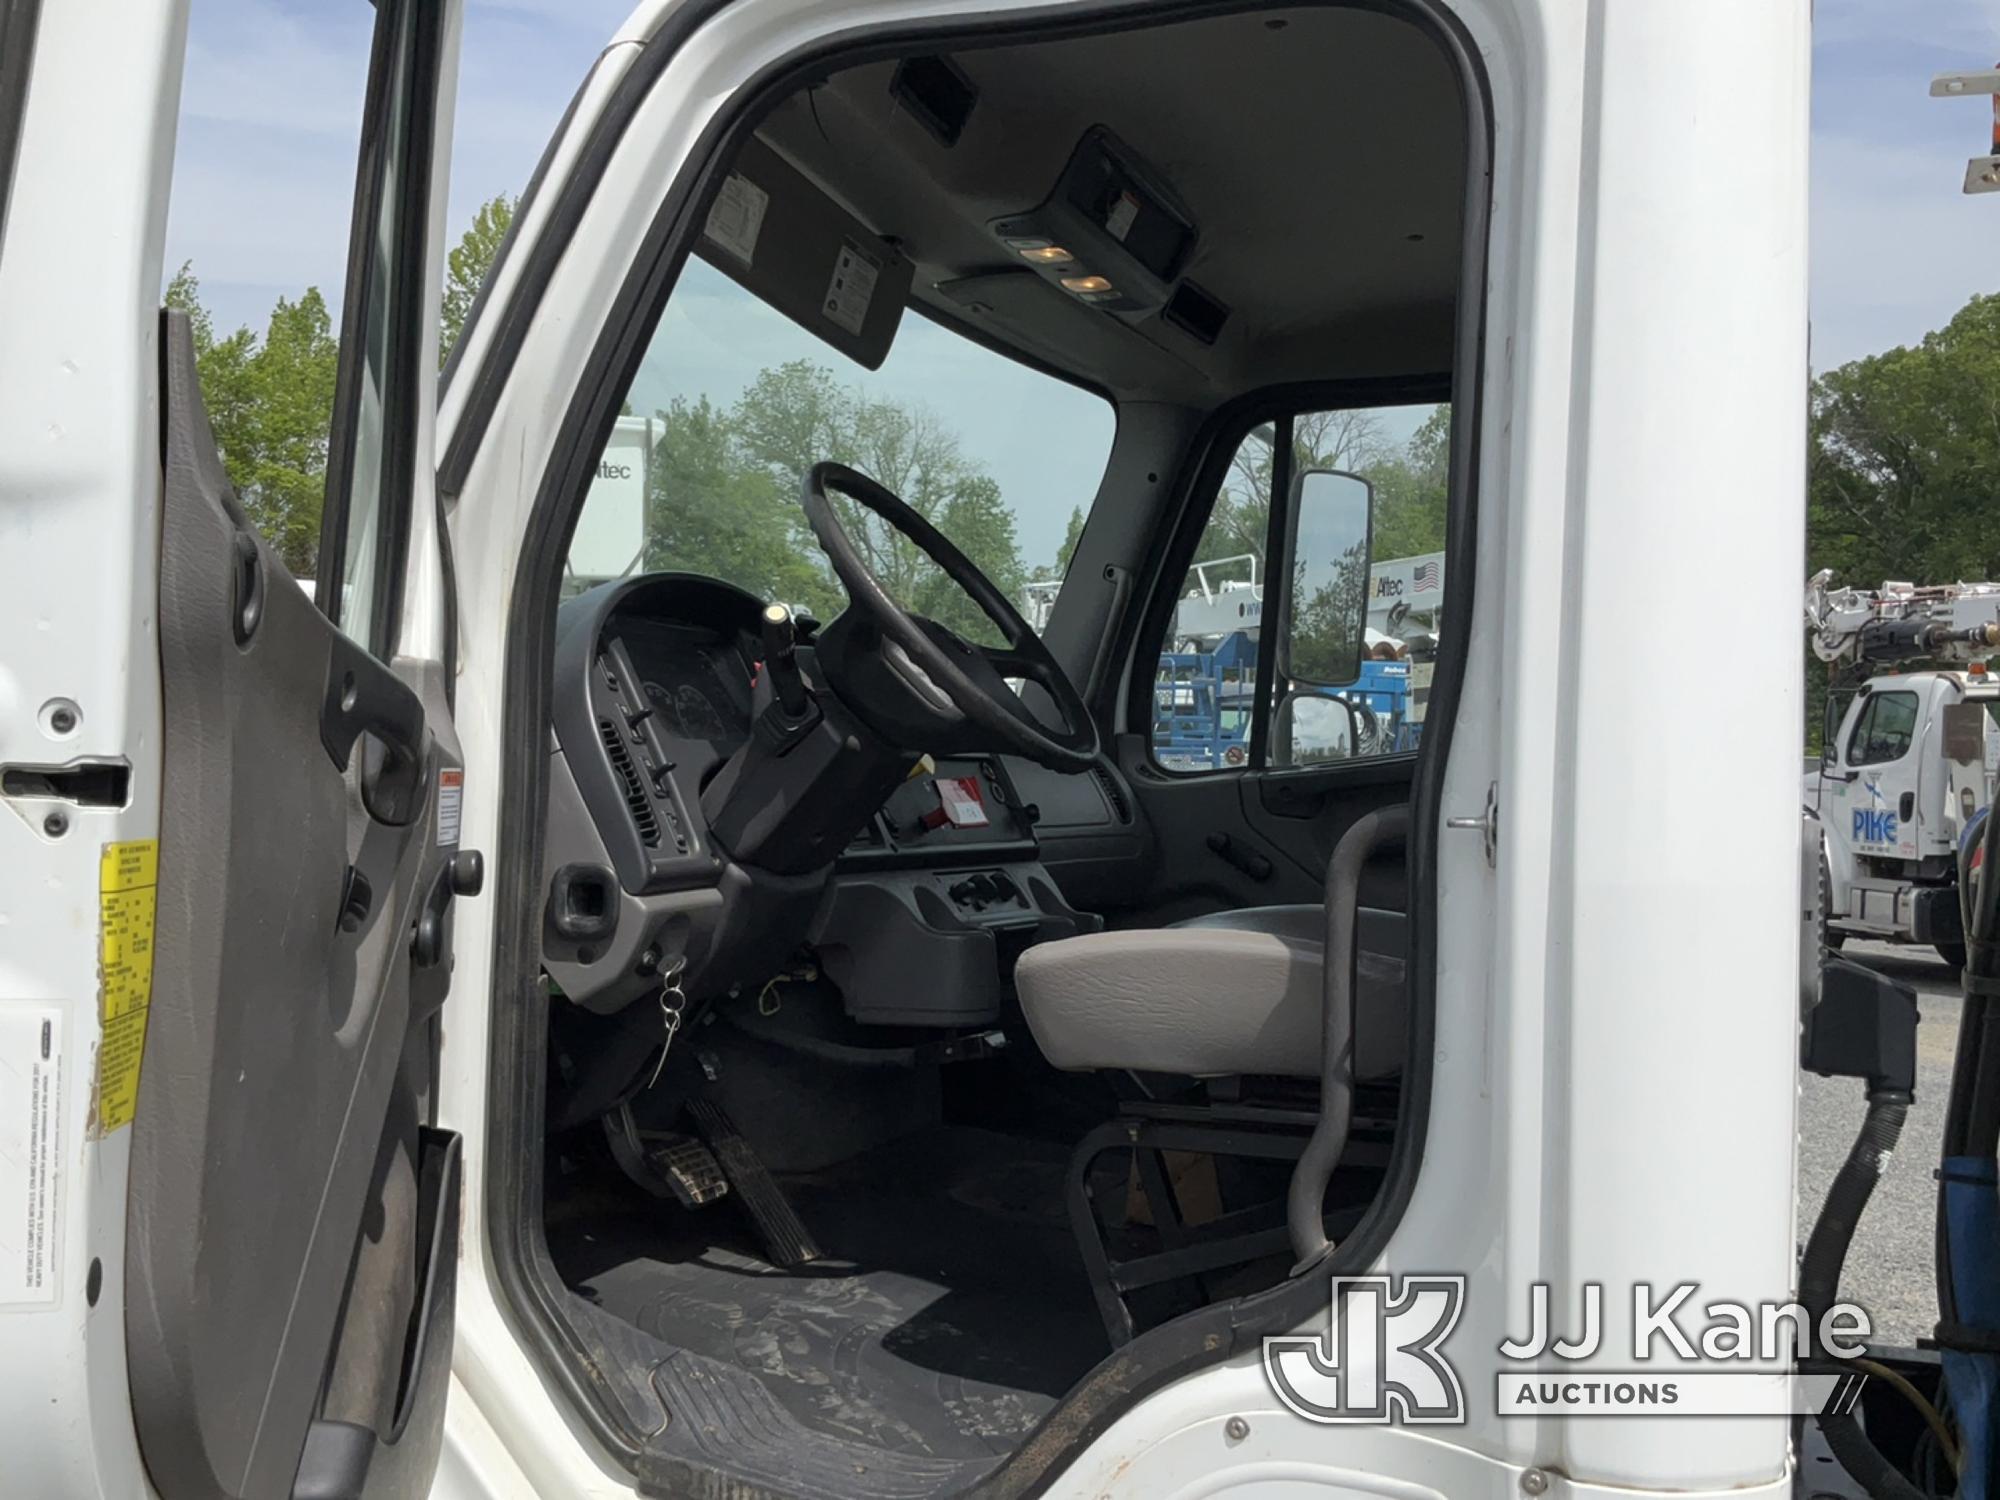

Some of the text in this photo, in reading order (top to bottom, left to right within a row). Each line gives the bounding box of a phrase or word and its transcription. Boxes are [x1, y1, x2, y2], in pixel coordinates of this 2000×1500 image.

[596, 461, 631, 480] ltec
[1376, 576, 1403, 597] Altec
[1852, 807, 1897, 844] PIKE
